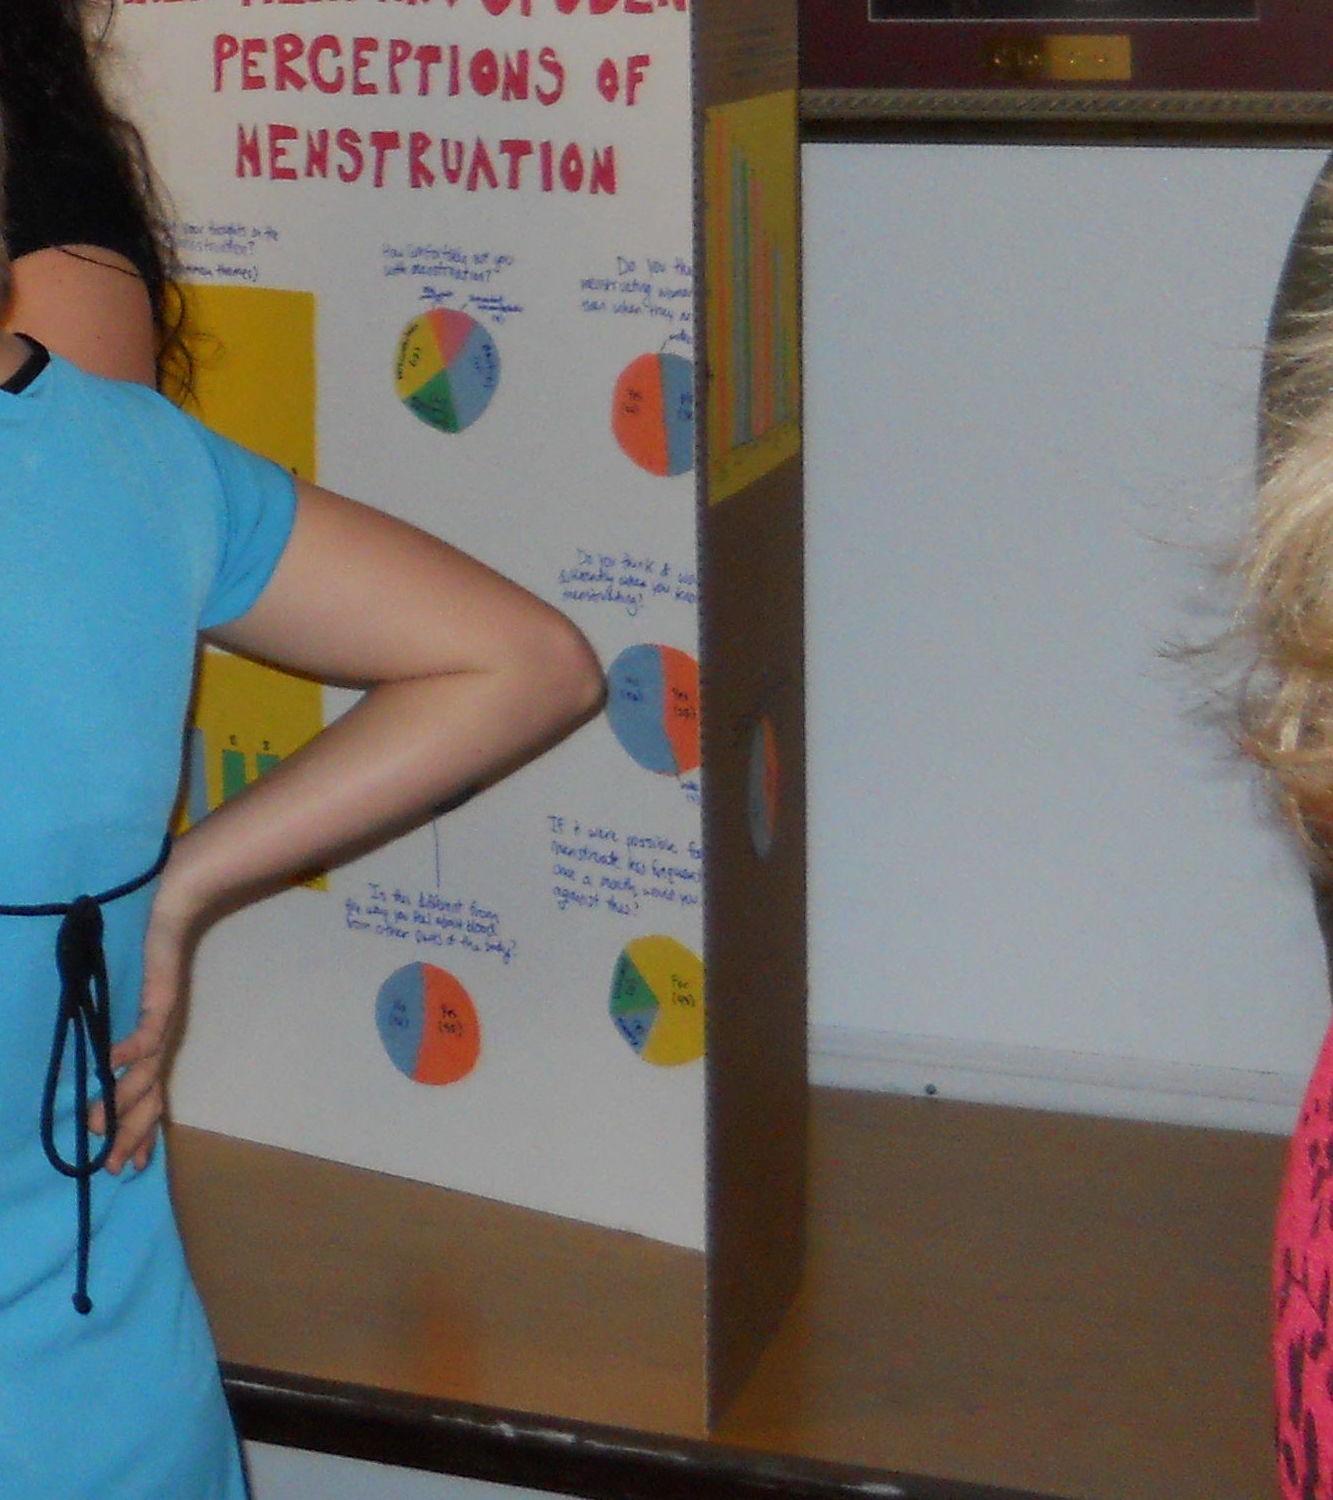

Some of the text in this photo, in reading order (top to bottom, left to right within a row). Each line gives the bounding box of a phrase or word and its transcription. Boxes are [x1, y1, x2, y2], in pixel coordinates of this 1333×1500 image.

[213, 34, 650, 106] PERCEPTIONS OF
[236, 124, 617, 195] MENSTRUATION
